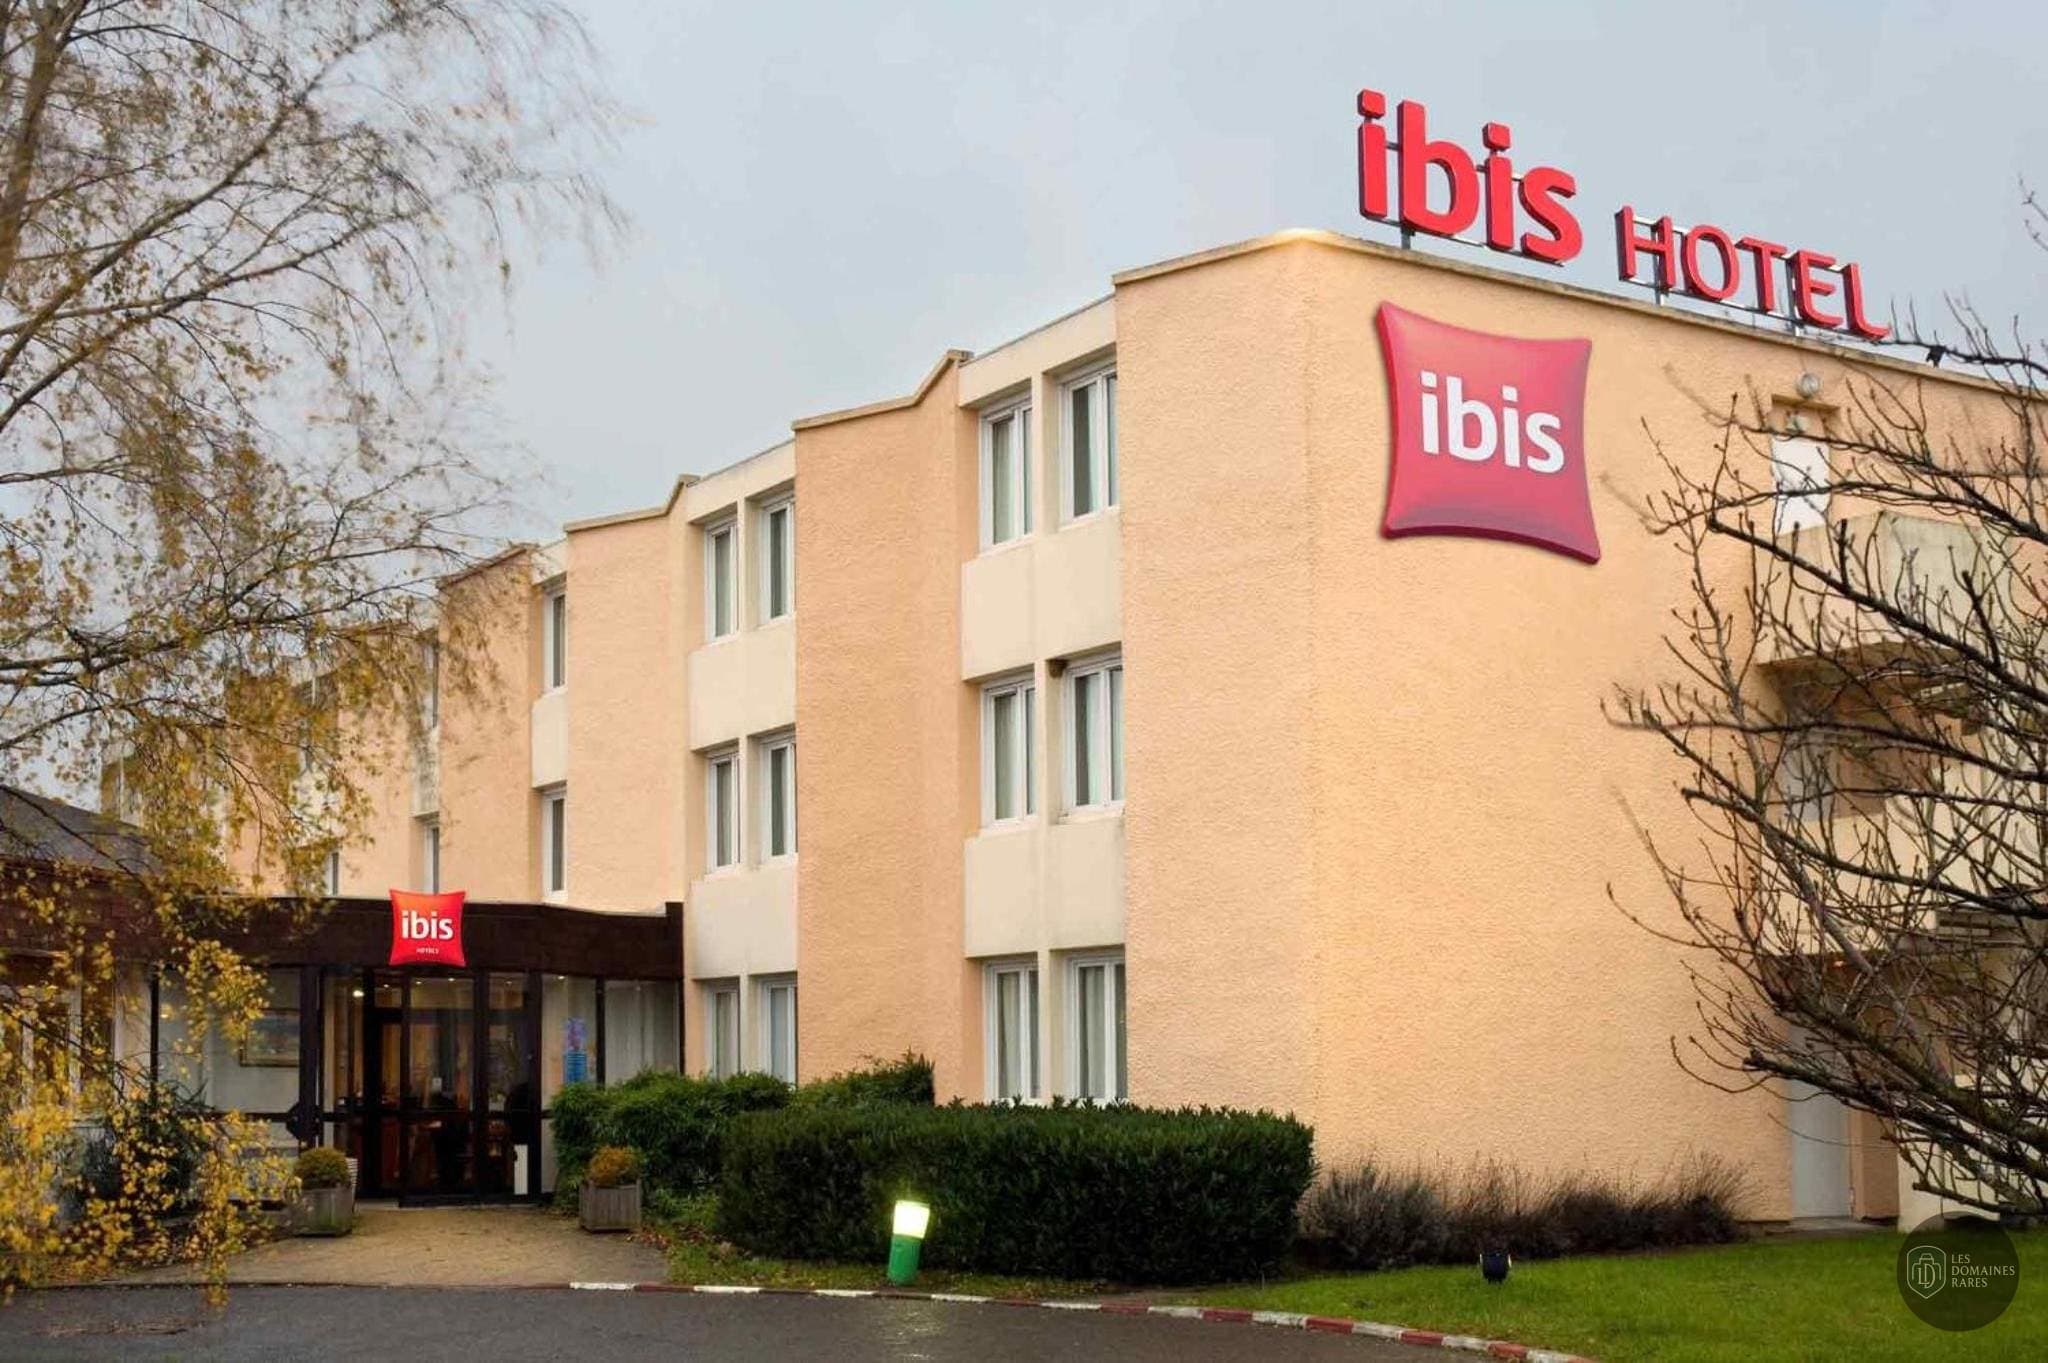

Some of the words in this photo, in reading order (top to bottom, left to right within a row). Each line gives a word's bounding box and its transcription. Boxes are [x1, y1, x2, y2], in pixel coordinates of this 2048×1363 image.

[1357, 89, 1583, 265] ibis
[1614, 205, 1889, 339] HOTEL
[1420, 370, 1565, 474] ibis
[401, 910, 454, 940] ibis
